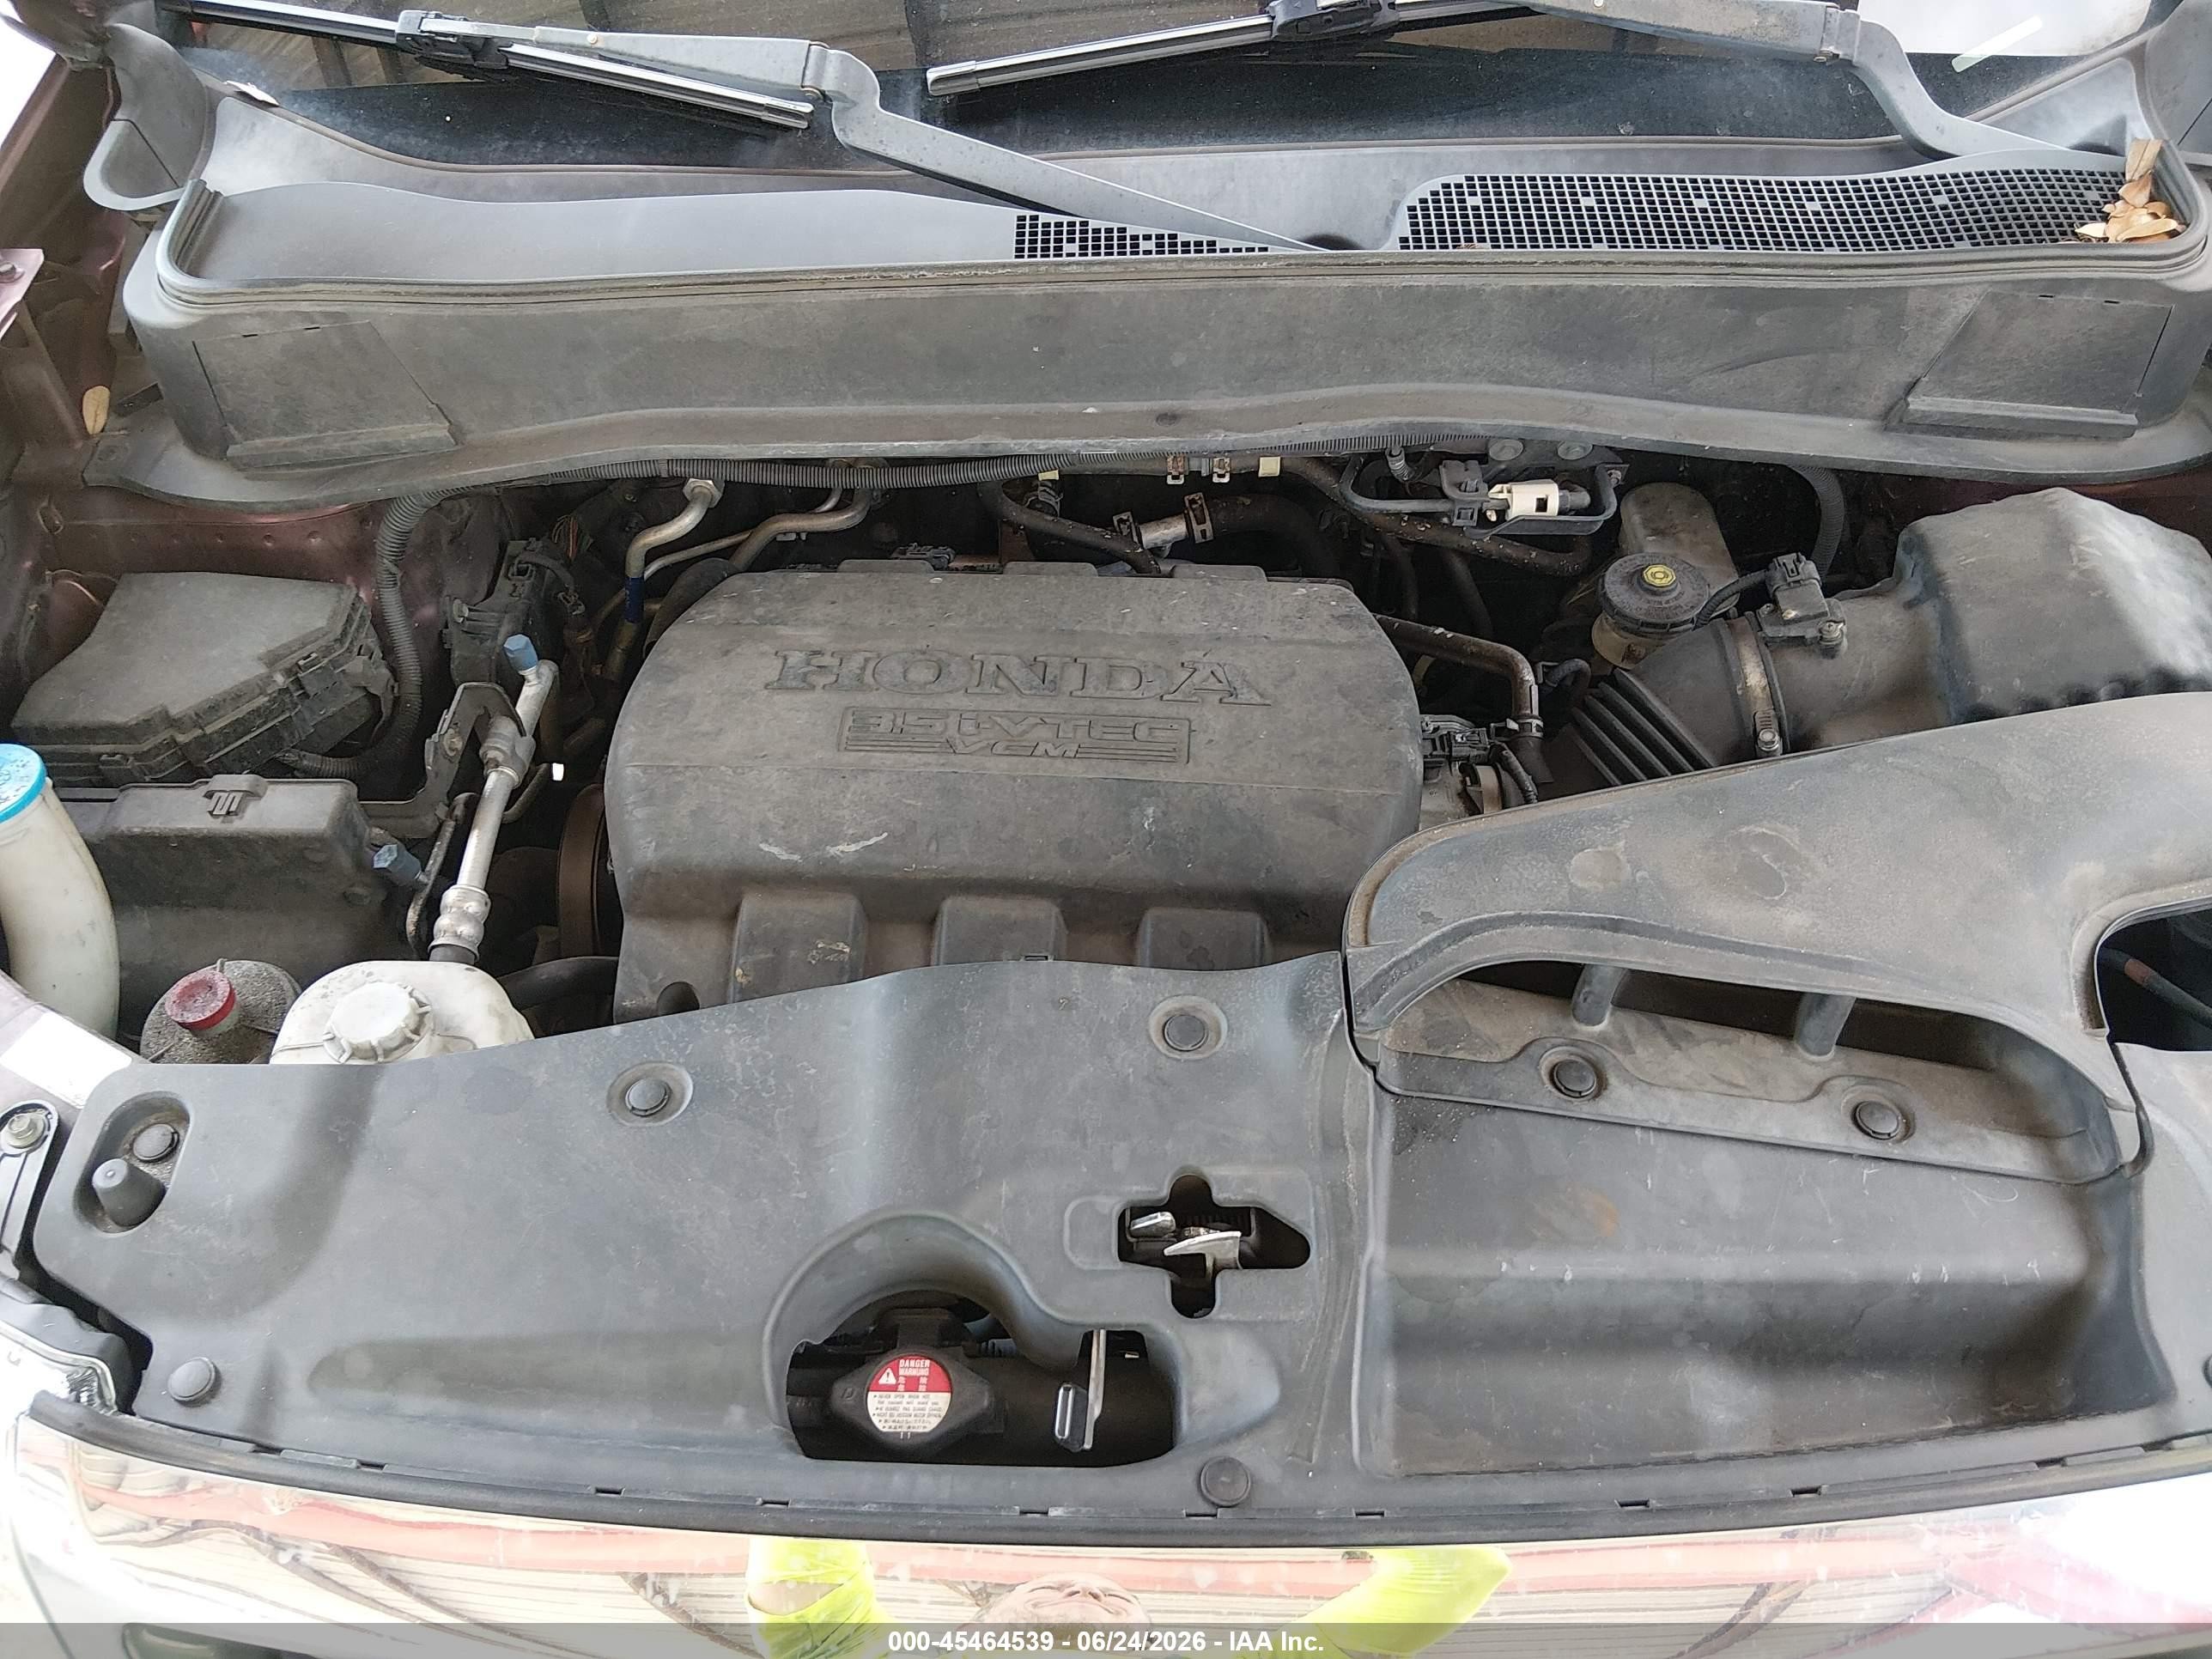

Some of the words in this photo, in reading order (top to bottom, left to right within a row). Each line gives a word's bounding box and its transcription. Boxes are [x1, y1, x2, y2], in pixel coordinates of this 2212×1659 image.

[766, 649, 1271, 706] HONDA
[945, 738, 1081, 759] VCM
[899, 1358, 931, 1368] DANGER
